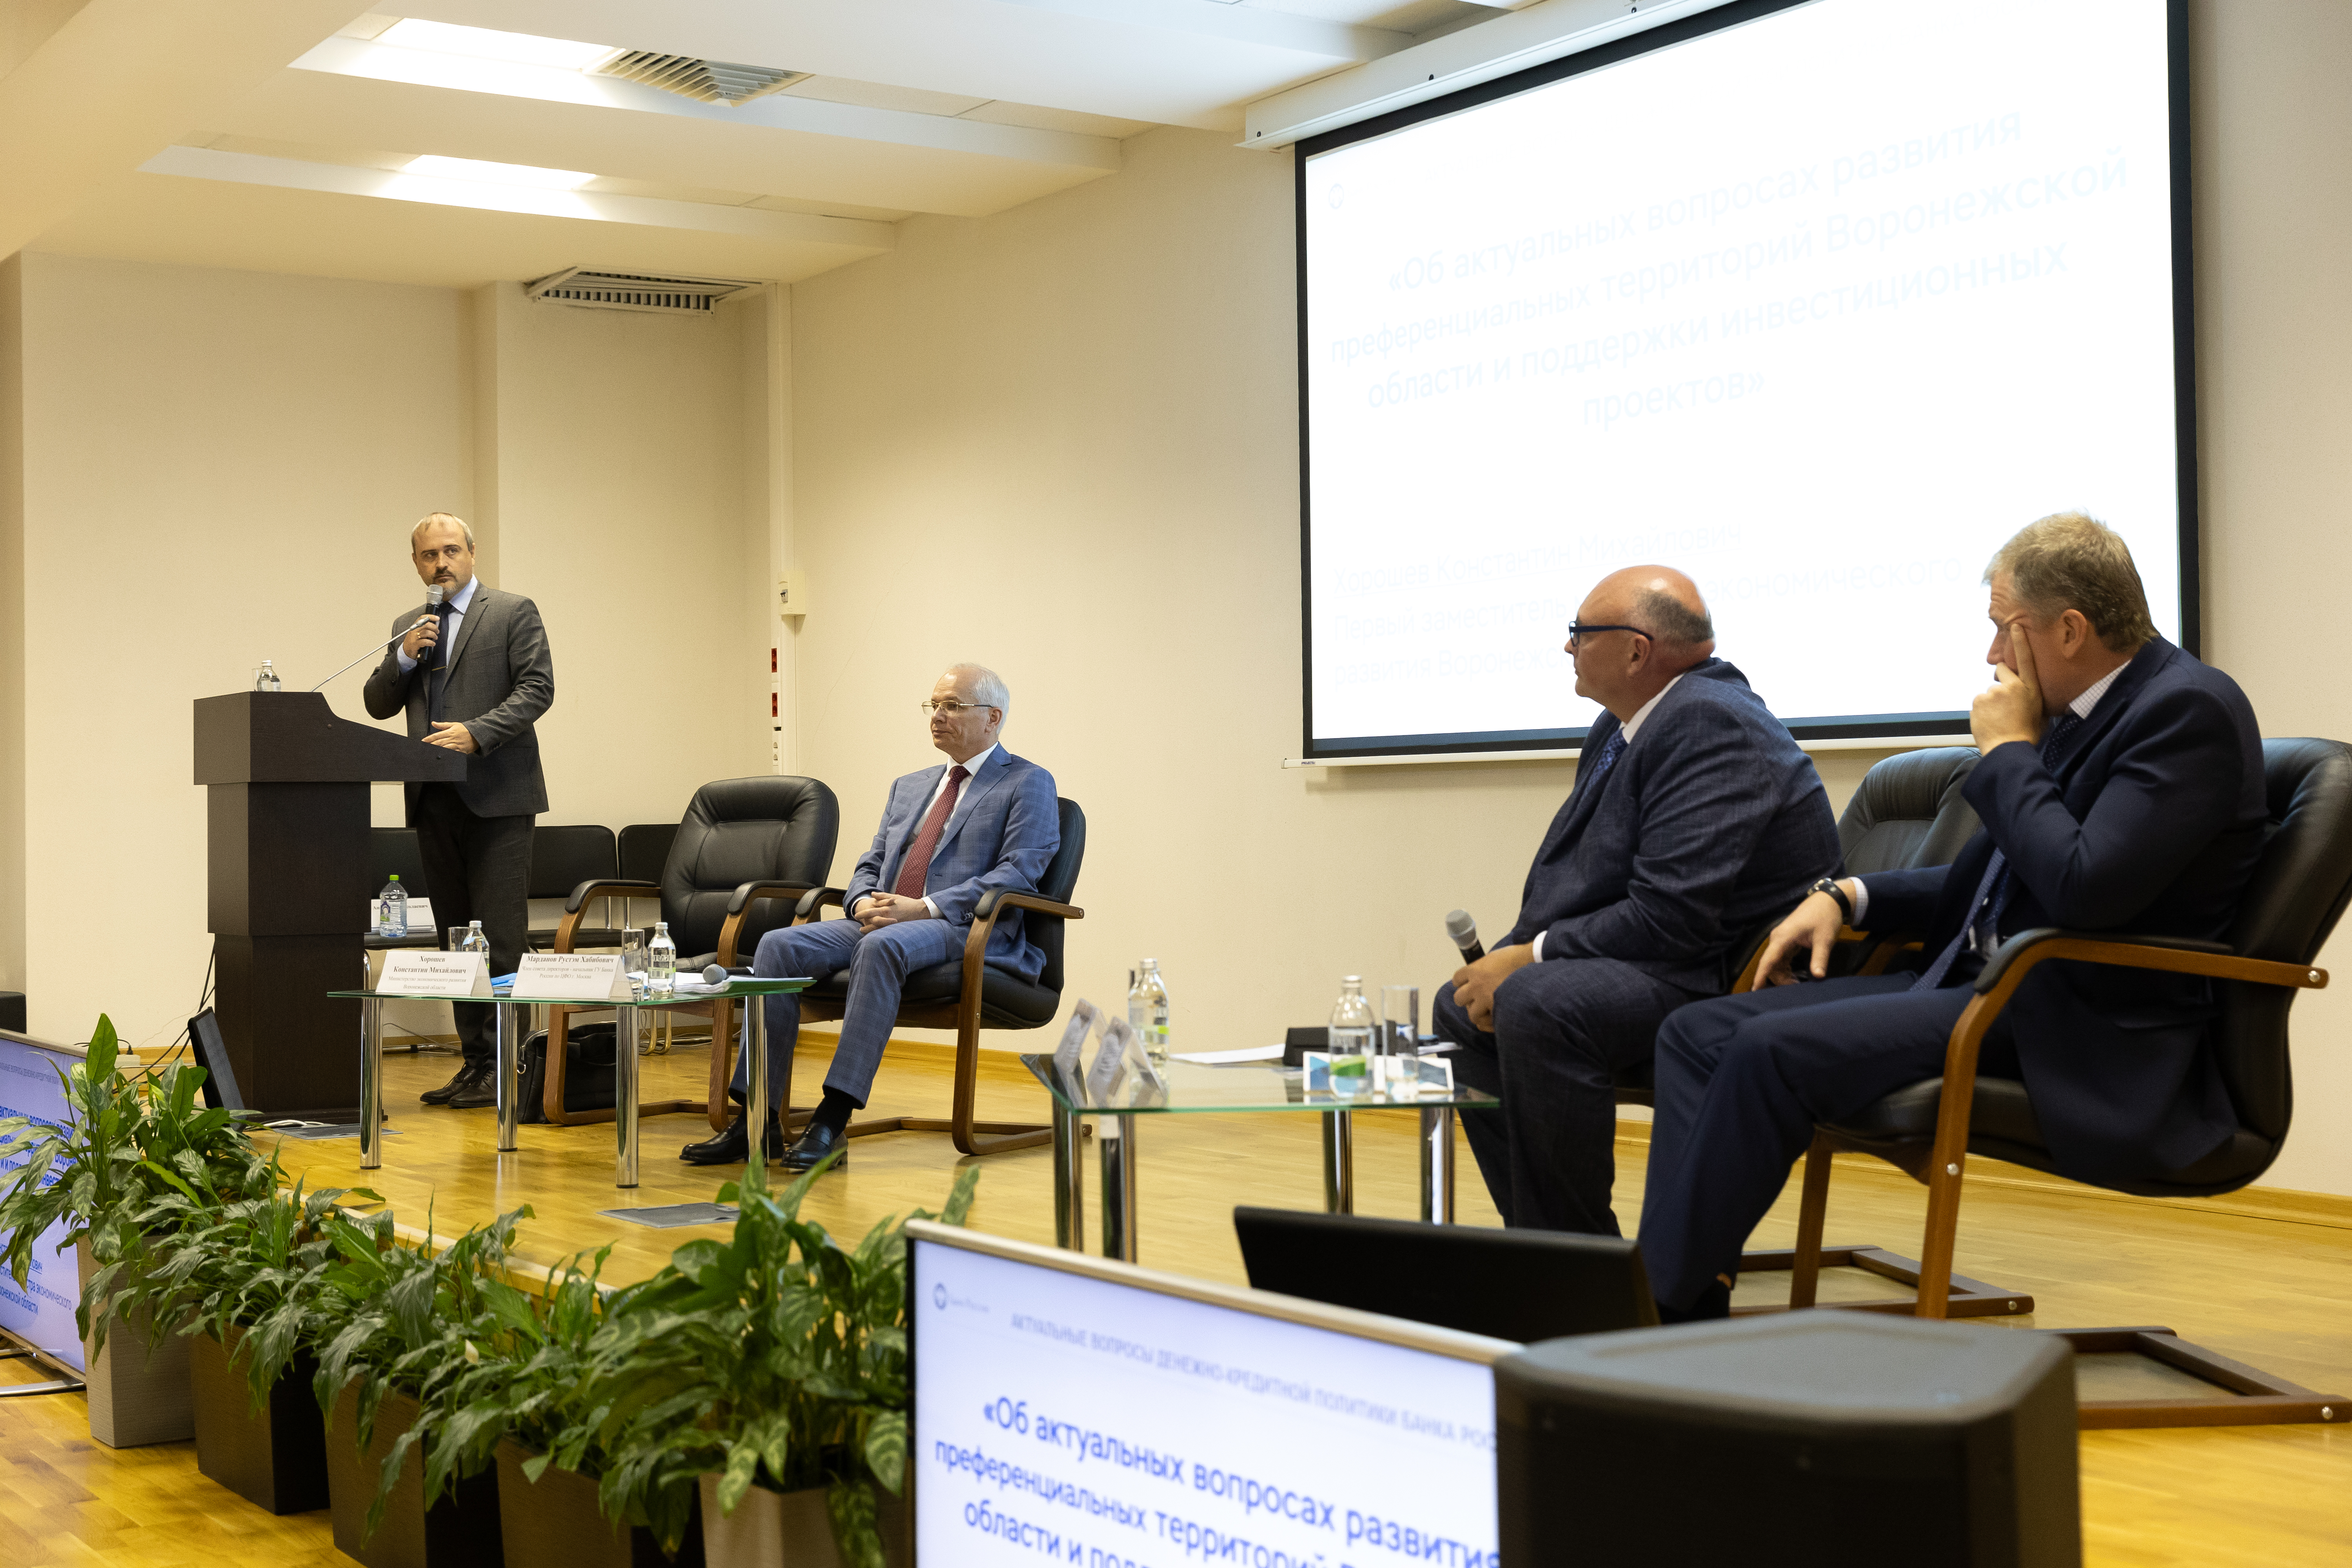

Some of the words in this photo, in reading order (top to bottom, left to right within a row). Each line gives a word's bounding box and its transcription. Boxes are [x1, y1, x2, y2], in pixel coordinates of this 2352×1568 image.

[1389, 250, 1444, 292] «Об
[1454, 212, 1635, 277] актуальных
[1647, 164, 1819, 227] вопросах
[1833, 111, 2021, 197] развития
[1332, 284, 1591, 367] преференциальных
[1600, 220, 1812, 304] территорий
[1827, 145, 2127, 252] Воронежской
[1368, 361, 1483, 408] области
[1494, 356, 1511, 383] и
[1522, 316, 1708, 376] поддержки
[1722, 241, 2068, 338] инвестиционных
[1584, 372, 1764, 432] проектов»
[1334, 564, 1430, 597] Хорошев
[1437, 544, 1570, 582] Константин
[1579, 523, 1741, 563] Михайлович
[1439, 645, 1572, 682] Воронежск
[21, 1295, 38, 1316] области
[935, 1440, 1147, 1532] преференциальных
[983, 1396, 1028, 1435] «Об
[1036, 1414, 1184, 1484] актуальных
[1194, 1463, 1335, 1532] вопросах
[964, 1498, 1060, 1558] области
[1068, 1538, 1082, 1566] и
